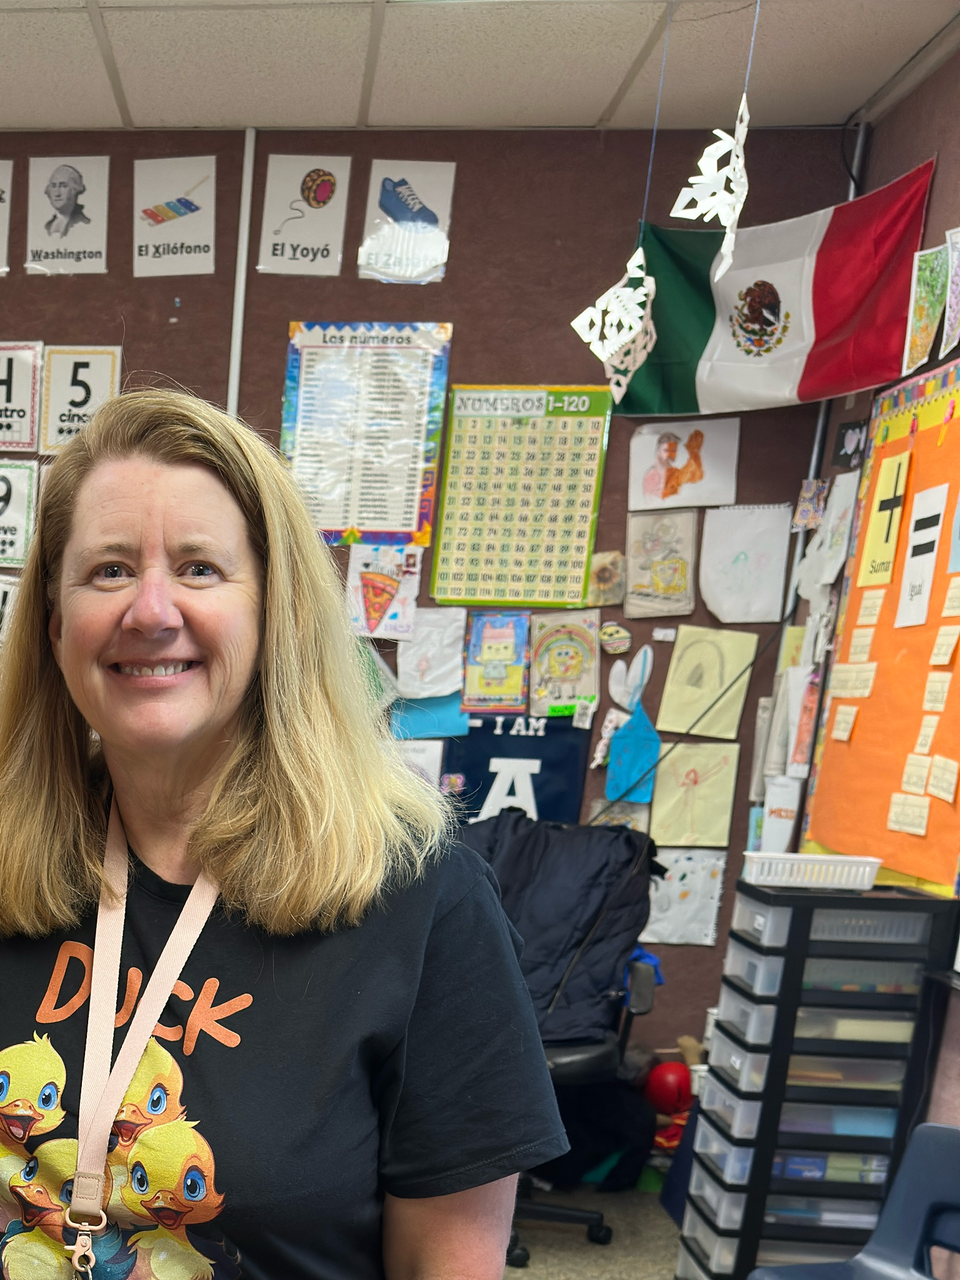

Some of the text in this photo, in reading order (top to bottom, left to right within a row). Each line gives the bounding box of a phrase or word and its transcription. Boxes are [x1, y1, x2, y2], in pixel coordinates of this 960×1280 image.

[31, 247, 102, 262] Washington
[138, 242, 211, 258] El Xilófono
[272, 242, 330, 260] El Yoyó
[323, 331, 412, 345] Los números
[68, 361, 91, 408] 5
[456, 396, 590, 413] NUMEROS 1-120
[494, 716, 548, 736] I AM
[468, 757, 542, 825] A
